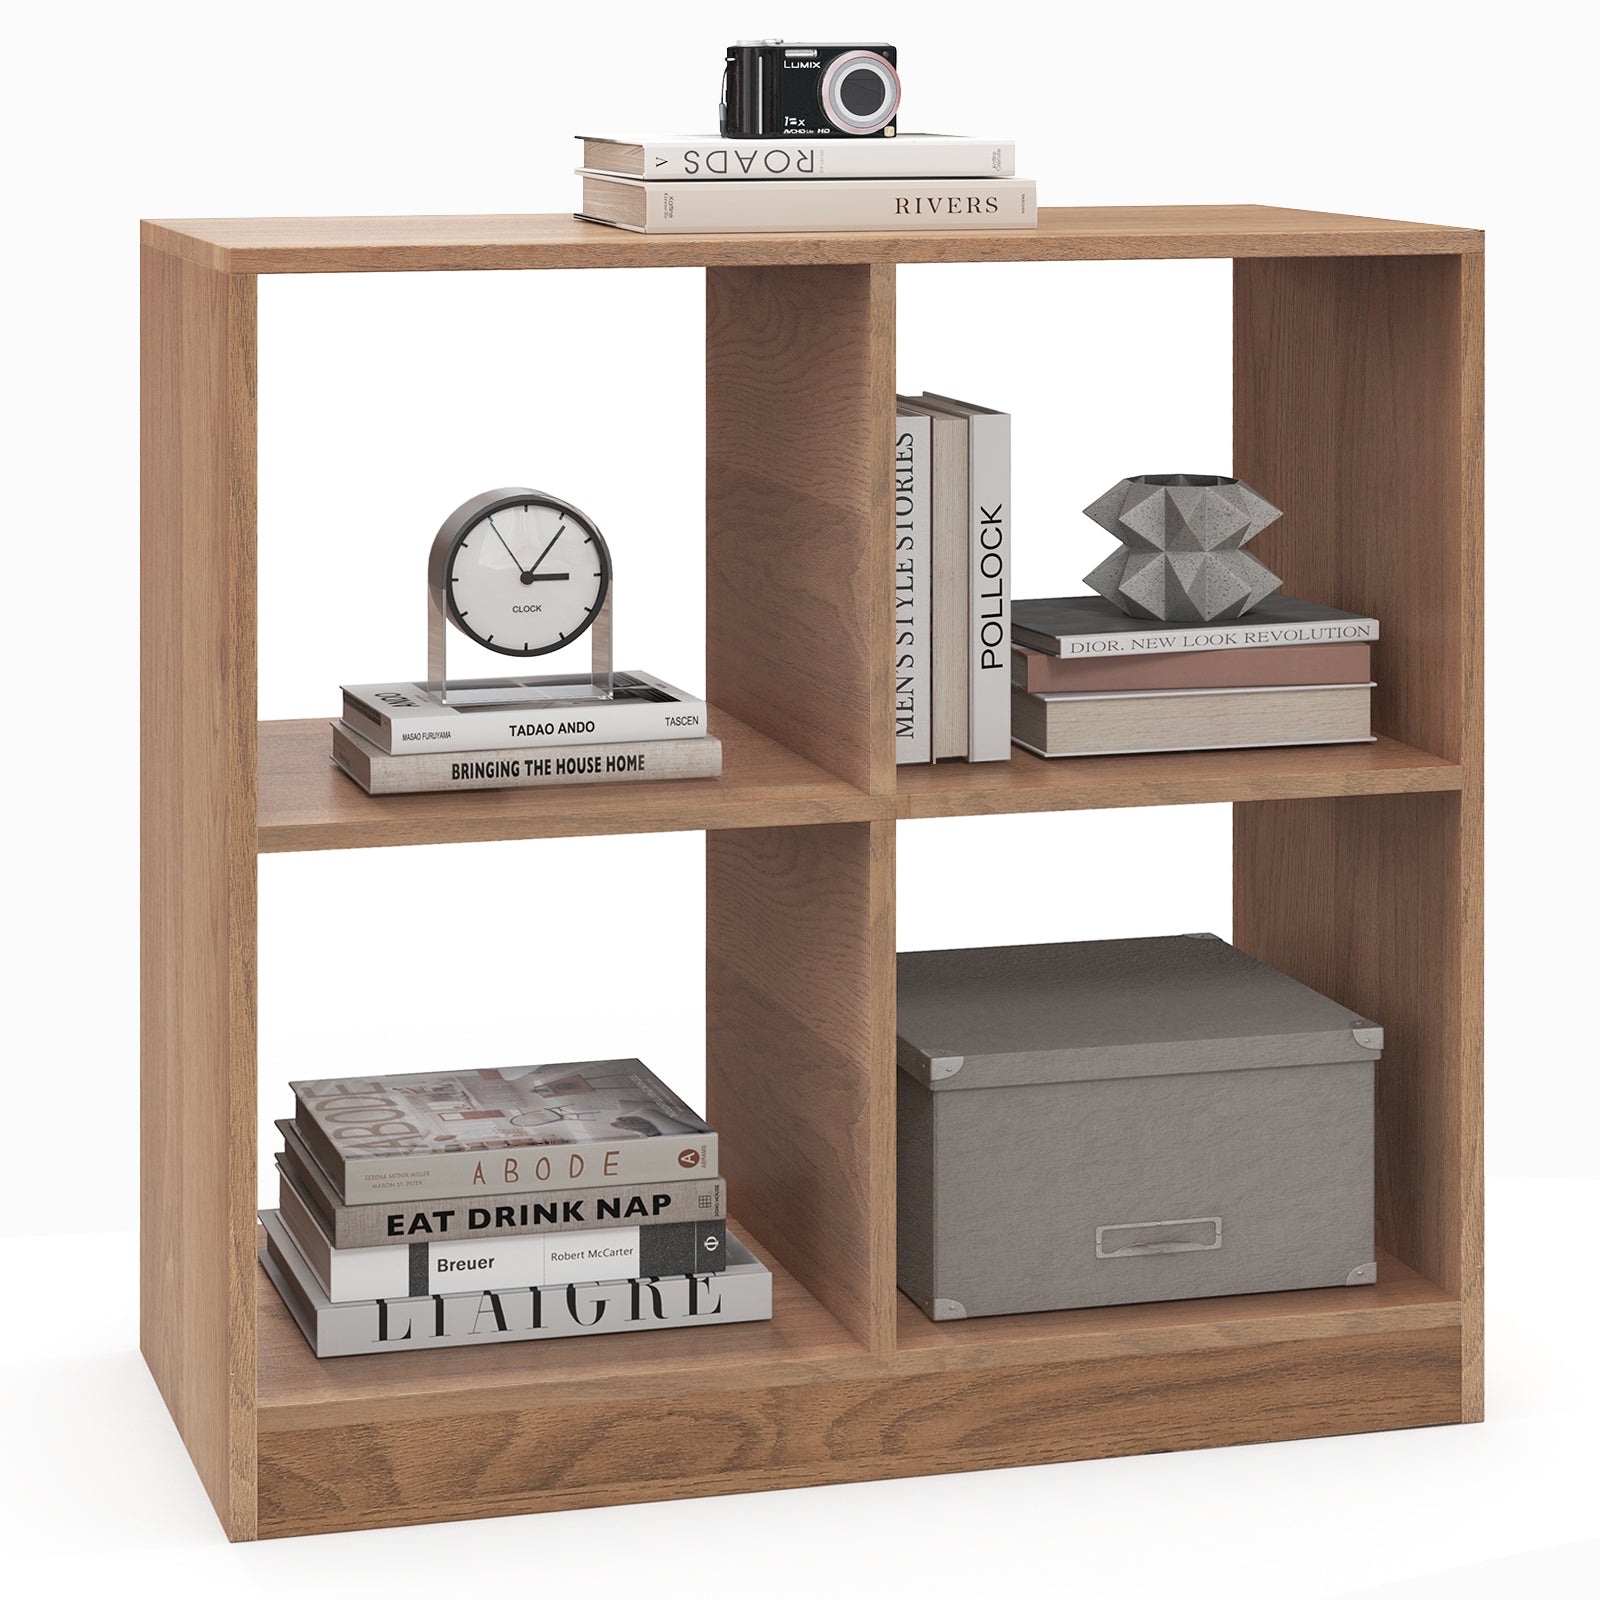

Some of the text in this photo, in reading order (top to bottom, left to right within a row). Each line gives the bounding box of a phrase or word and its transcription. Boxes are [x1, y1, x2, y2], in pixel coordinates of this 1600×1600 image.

[783, 60, 821, 69] LUMIX
[684, 149, 815, 175] ROADS
[894, 196, 1000, 215] RIVERS
[896, 431, 915, 552] STORIES
[980, 503, 1004, 671] POLLOCK
[512, 605, 542, 613] CLOCK
[896, 557, 915, 649] STYLE
[1070, 624, 1372, 654] DIOR. NEW LOOK REVOLUTION
[509, 720, 596, 738] TADAO ANDO
[664, 715, 700, 728] TASCEN
[402, 731, 451, 742] MASAO FURUYAMA
[452, 754, 646, 781] BRINGING THE HOUSE HOME
[300, 1080, 429, 1149] ABODE
[472, 1150, 621, 1185] ABODE
[386, 1193, 673, 1238] EAT DRINK NAP
[436, 1254, 496, 1274] Breuer
[550, 1244, 635, 1263] Robert McCarter
